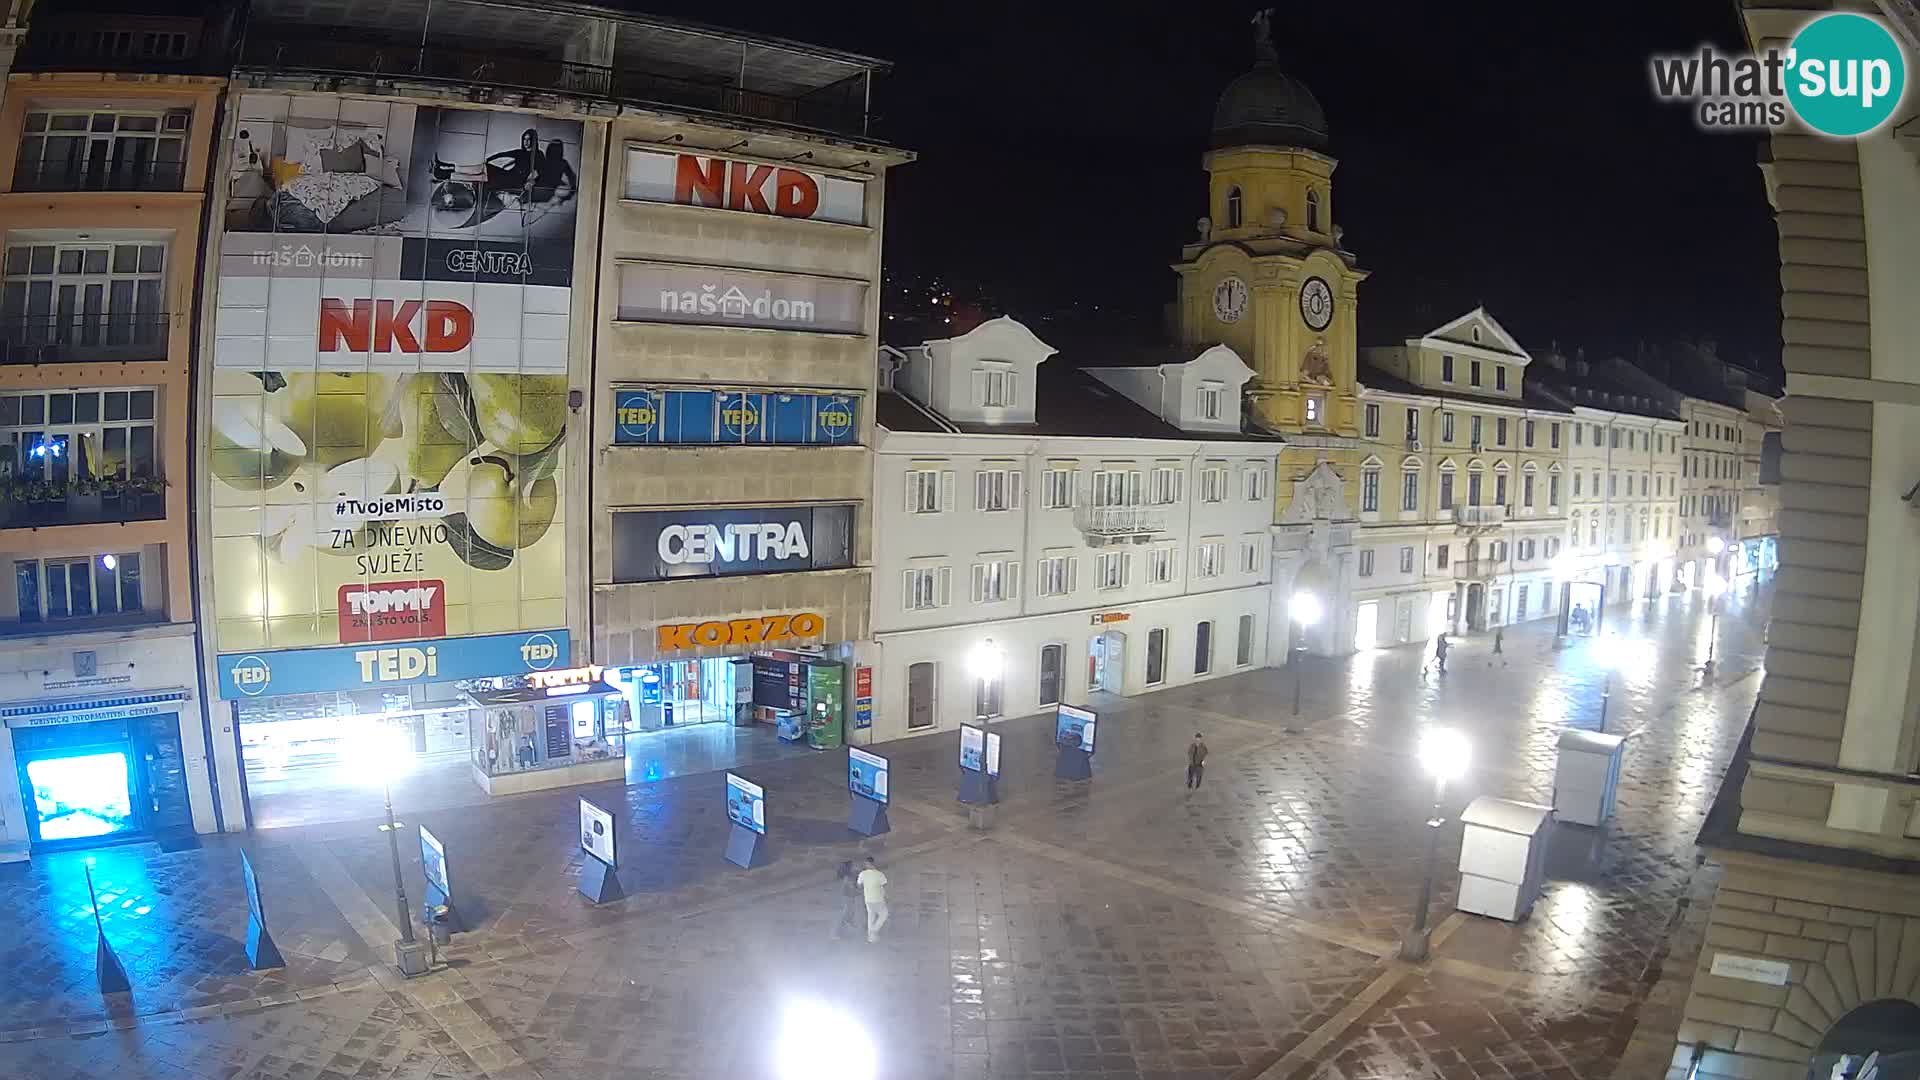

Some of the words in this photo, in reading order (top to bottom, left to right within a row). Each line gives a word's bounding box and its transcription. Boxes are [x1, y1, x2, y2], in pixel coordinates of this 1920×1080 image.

[674, 153, 819, 219] NKD
[252, 244, 291, 268] naš
[317, 246, 364, 268] dom
[446, 249, 533, 275] CENTRA
[659, 283, 717, 315] naš
[752, 289, 816, 323] dom
[319, 297, 475, 353] NKD
[336, 497, 444, 517] #TvojeMisto
[331, 528, 356, 549] ZA
[364, 524, 449, 548] DNEVNO
[657, 521, 809, 565] CENTRA
[356, 547, 425, 576] SVJEŽE
[346, 587, 437, 615] TOMMY
[657, 612, 824, 651] KORZO
[355, 646, 438, 684] TEDi
[520, 641, 558, 662] TEDi
[232, 660, 271, 685] TEDi
